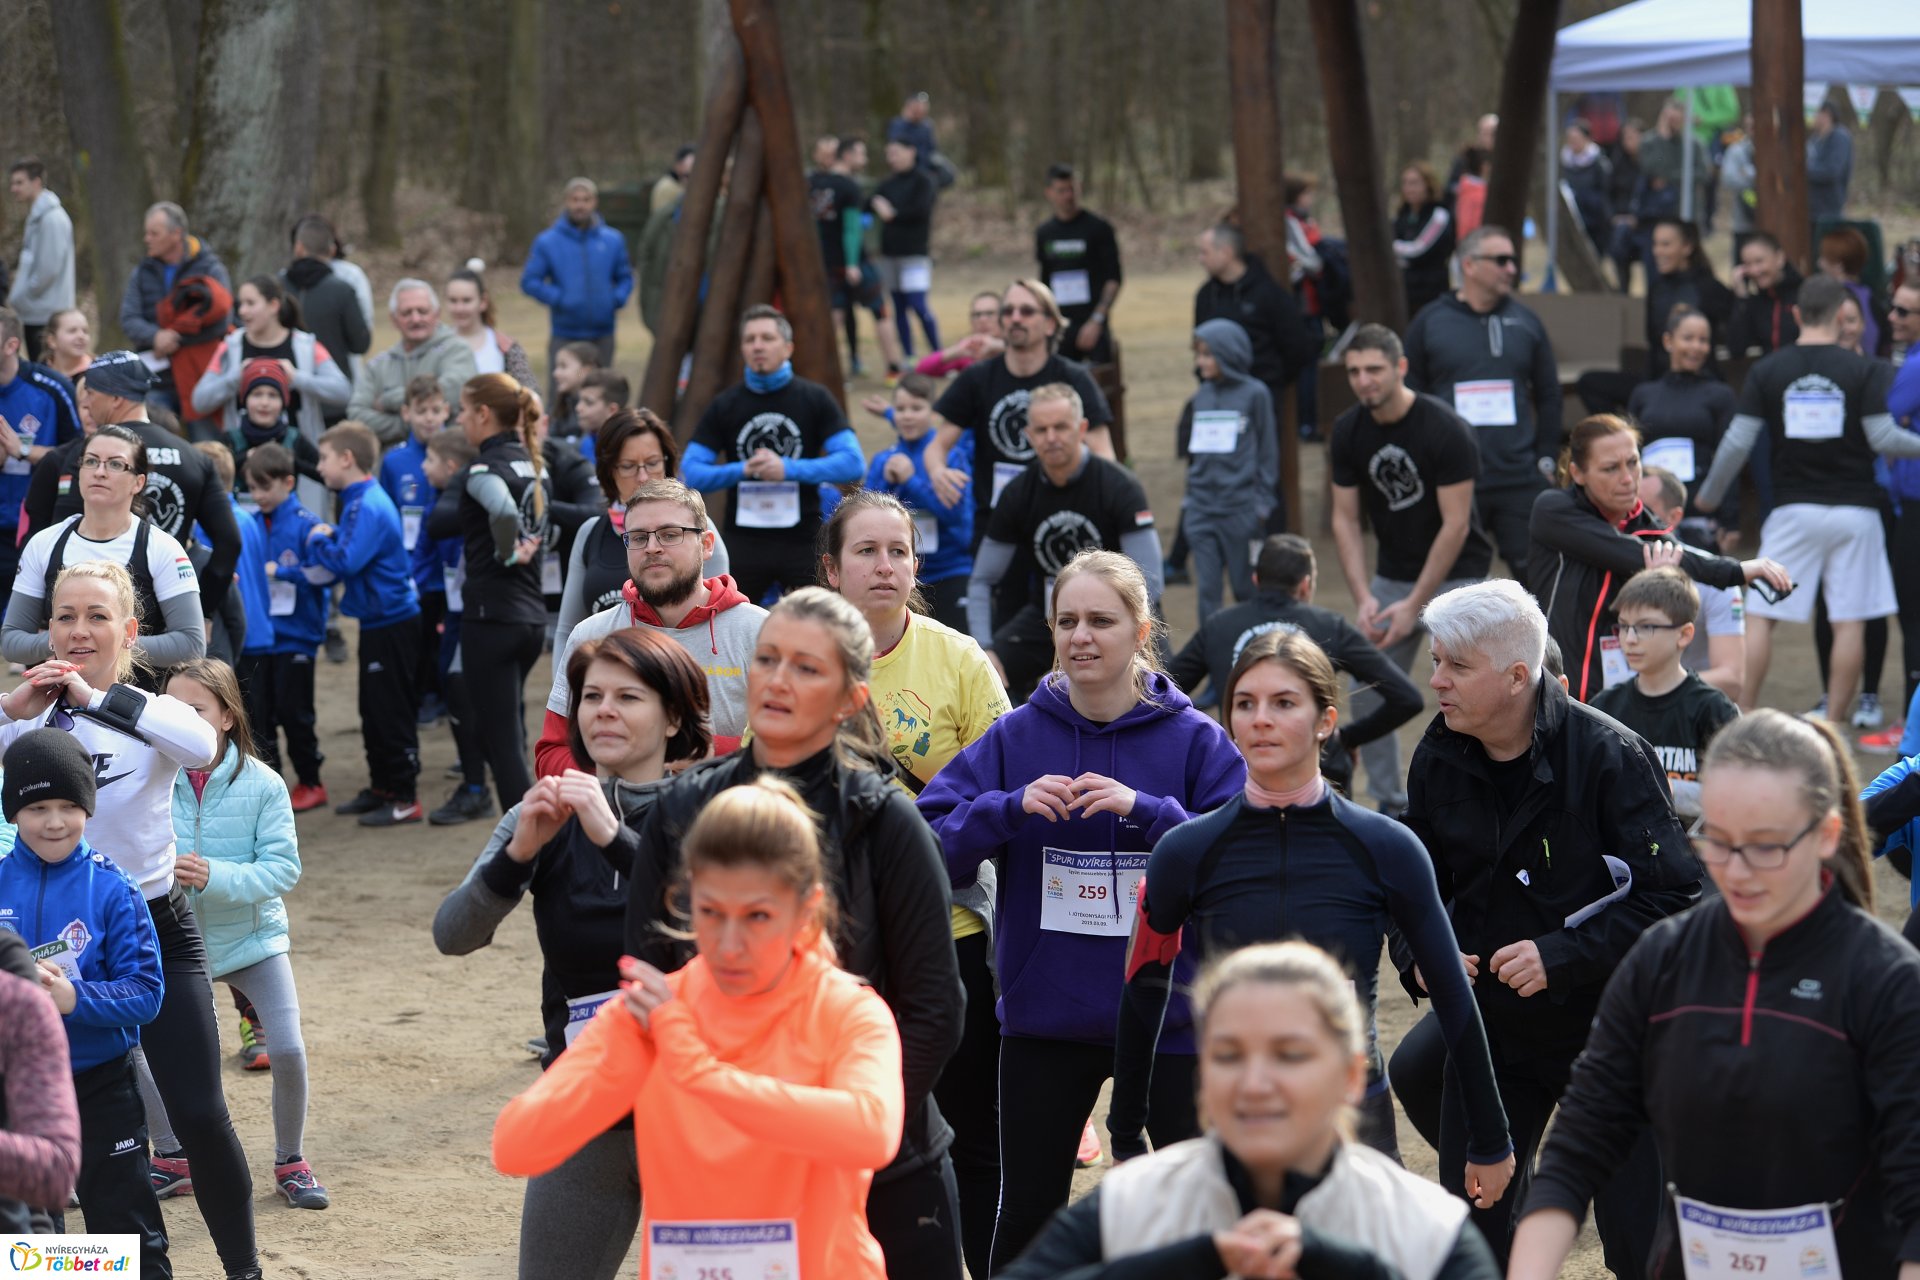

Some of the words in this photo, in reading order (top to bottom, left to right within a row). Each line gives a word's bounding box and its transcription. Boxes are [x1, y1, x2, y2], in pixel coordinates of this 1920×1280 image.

[23, 780, 51, 793] Columbia
[1078, 884, 1107, 900] 259
[115, 1137, 136, 1151] JAKO
[1729, 1251, 1767, 1273] 267
